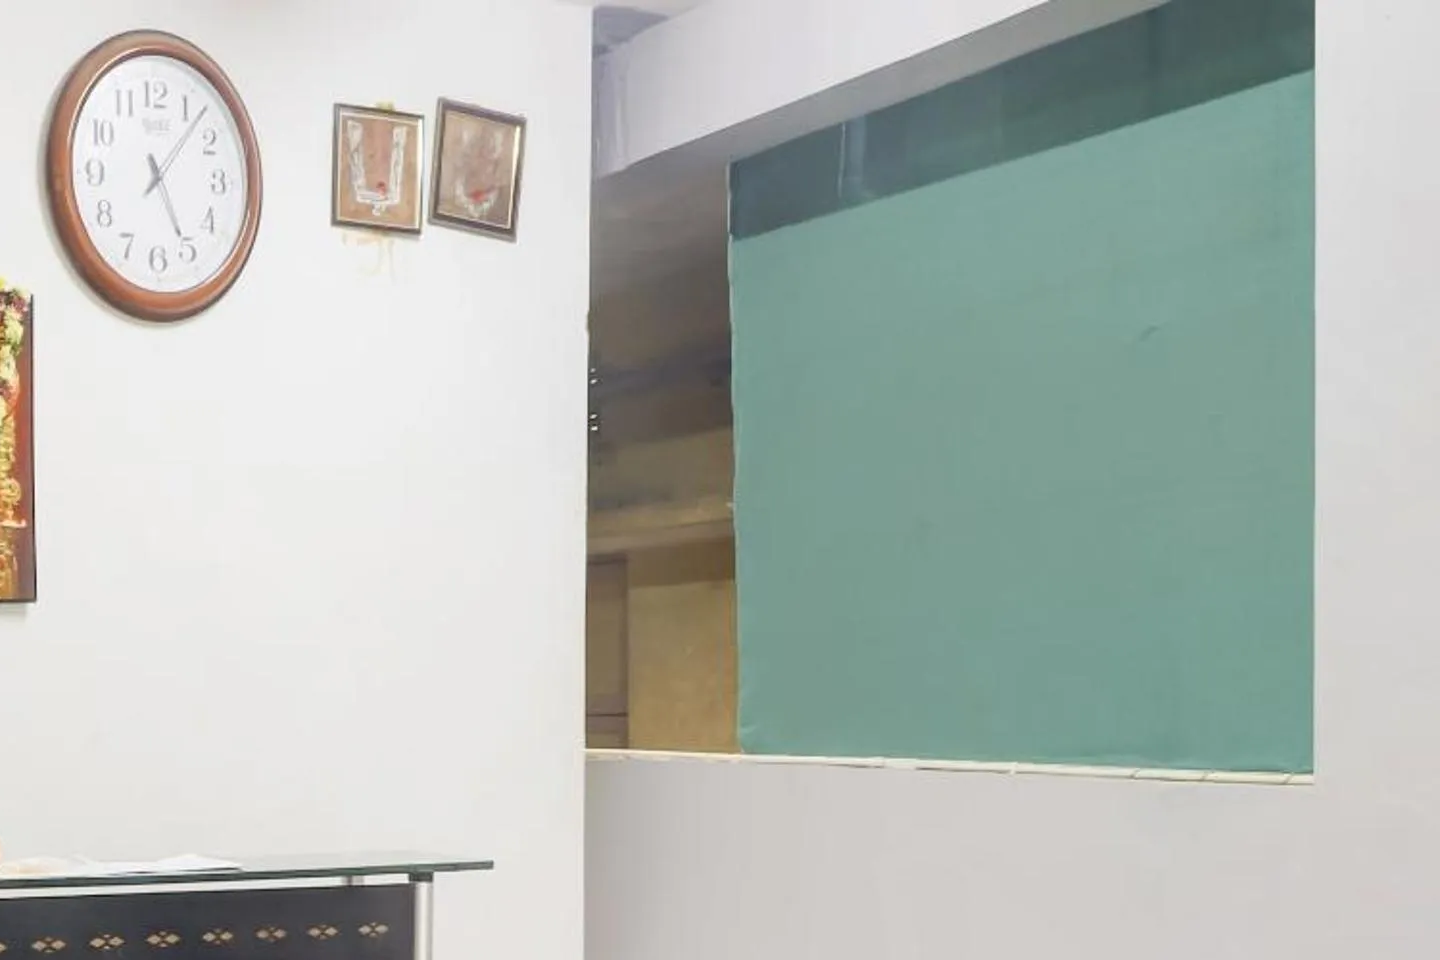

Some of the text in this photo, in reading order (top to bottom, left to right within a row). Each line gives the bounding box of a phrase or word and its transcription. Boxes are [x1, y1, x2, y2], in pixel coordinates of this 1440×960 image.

[116, 89, 134, 117] 11
[145, 81, 168, 108] 12
[182, 94, 189, 122] 1
[93, 119, 114, 146] 10
[203, 128, 217, 156] 2
[85, 158, 105, 186] 9
[211, 168, 226, 194] 3
[97, 200, 112, 228] 8
[201, 206, 214, 234] 4
[119, 232, 134, 260] 7
[149, 246, 168, 273] 6
[179, 237, 197, 262] 5
